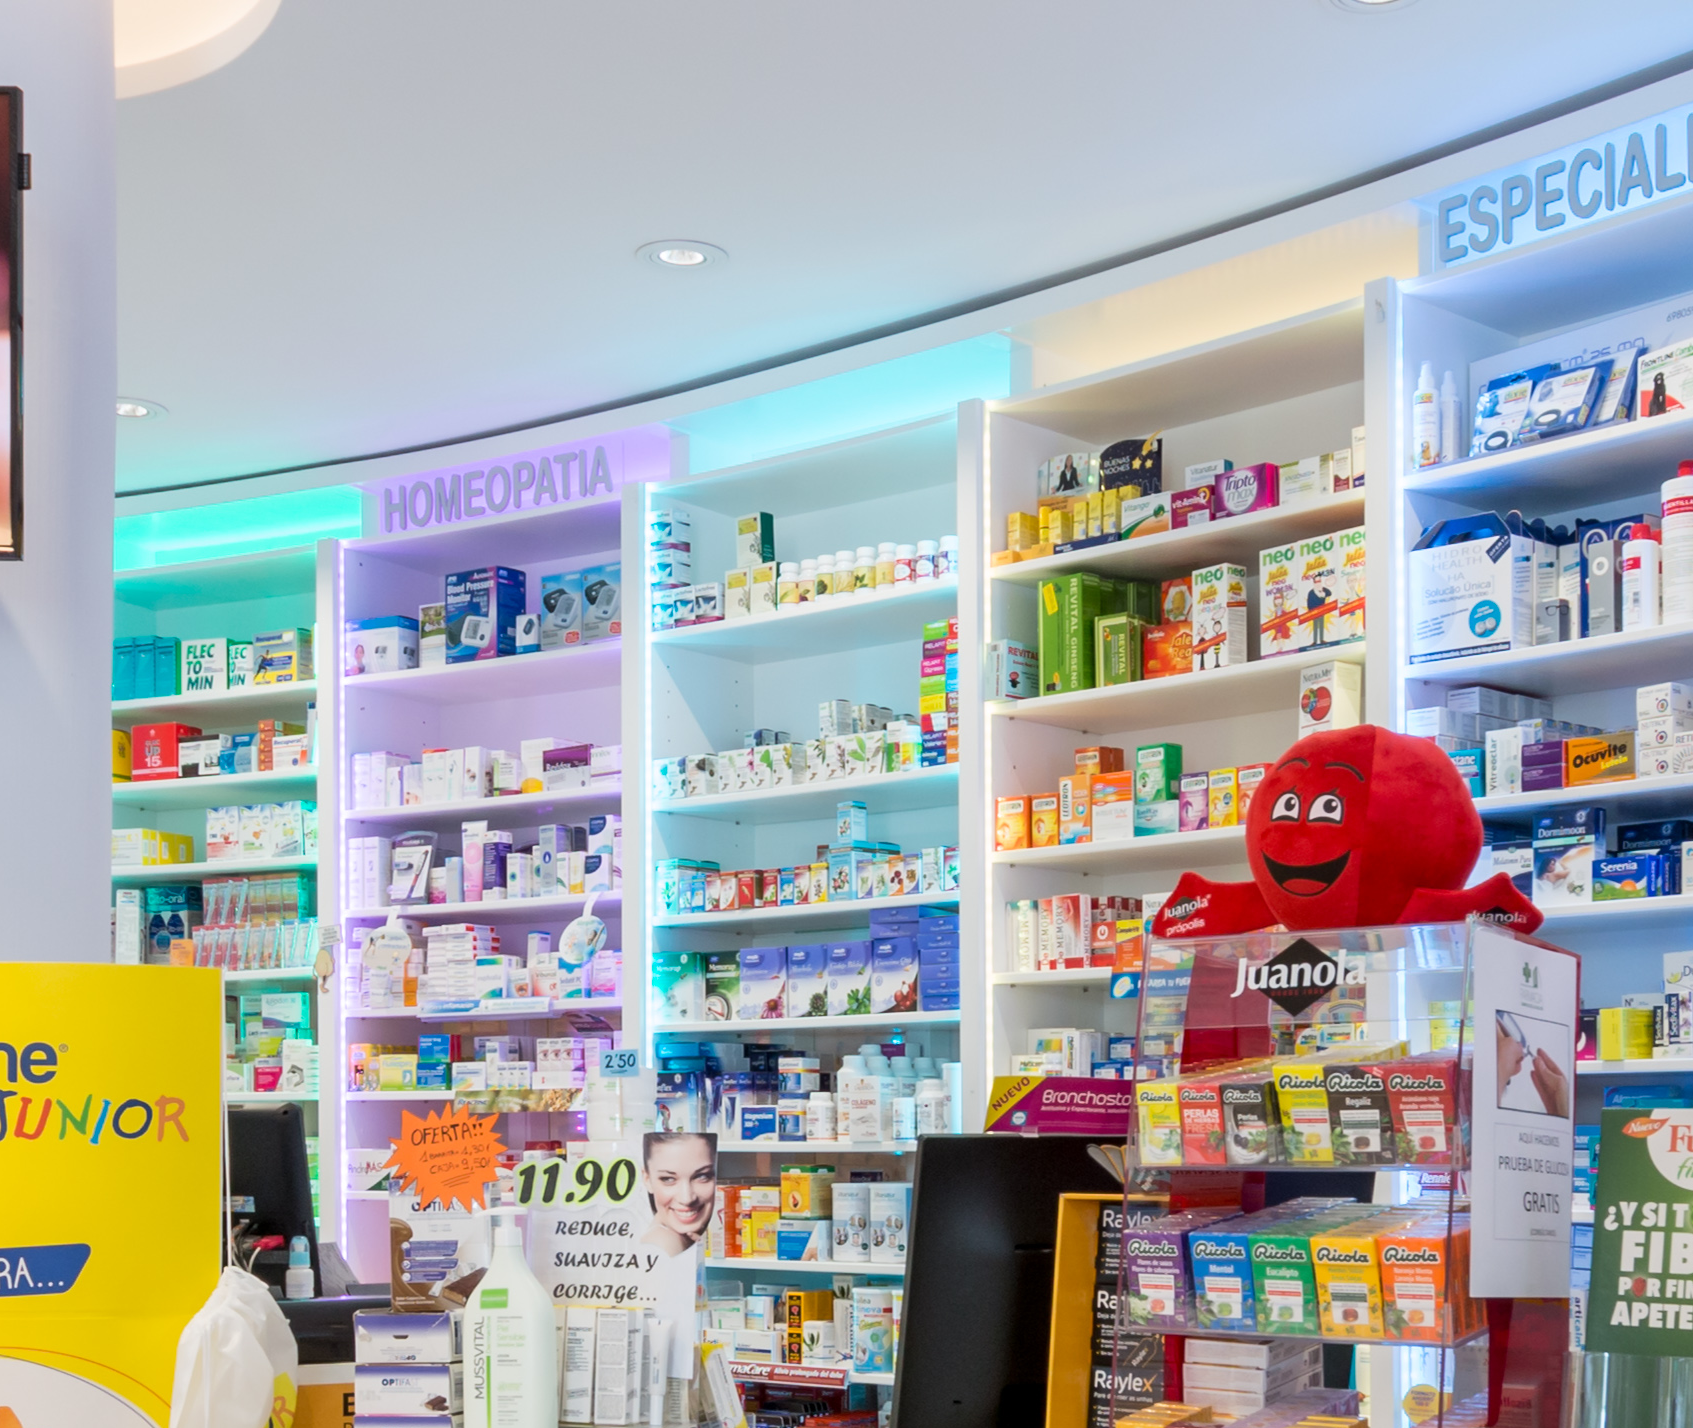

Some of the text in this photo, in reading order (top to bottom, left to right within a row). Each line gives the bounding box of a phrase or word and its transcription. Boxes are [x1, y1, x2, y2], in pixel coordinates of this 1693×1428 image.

[383, 446, 612, 533] HOMEOPATIA
[1222, 473, 1257, 491] Tripto
[1069, 577, 1080, 629] REVITAL
[187, 643, 214, 660] FLEC
[187, 659, 201, 675] TO
[187, 675, 214, 691] MIN
[1573, 740, 1628, 770] Ocuvite
[1600, 859, 1640, 875] Serenia
[1231, 951, 1367, 997] Juanola
[1390, 1075, 1444, 1091] Ricola
[991, 1076, 1031, 1112] NUEVO
[1042, 1088, 1131, 1108] Bronchosto
[517, 1157, 637, 1205] 11.90
[1523, 1191, 1560, 1215] GRATIS
[1643, 1204, 1670, 1230] SI
[554, 1250, 640, 1269] SUAVIZA
[1255, 1244, 1306, 1262] Ricola
[1317, 1247, 1370, 1265] Ricola
